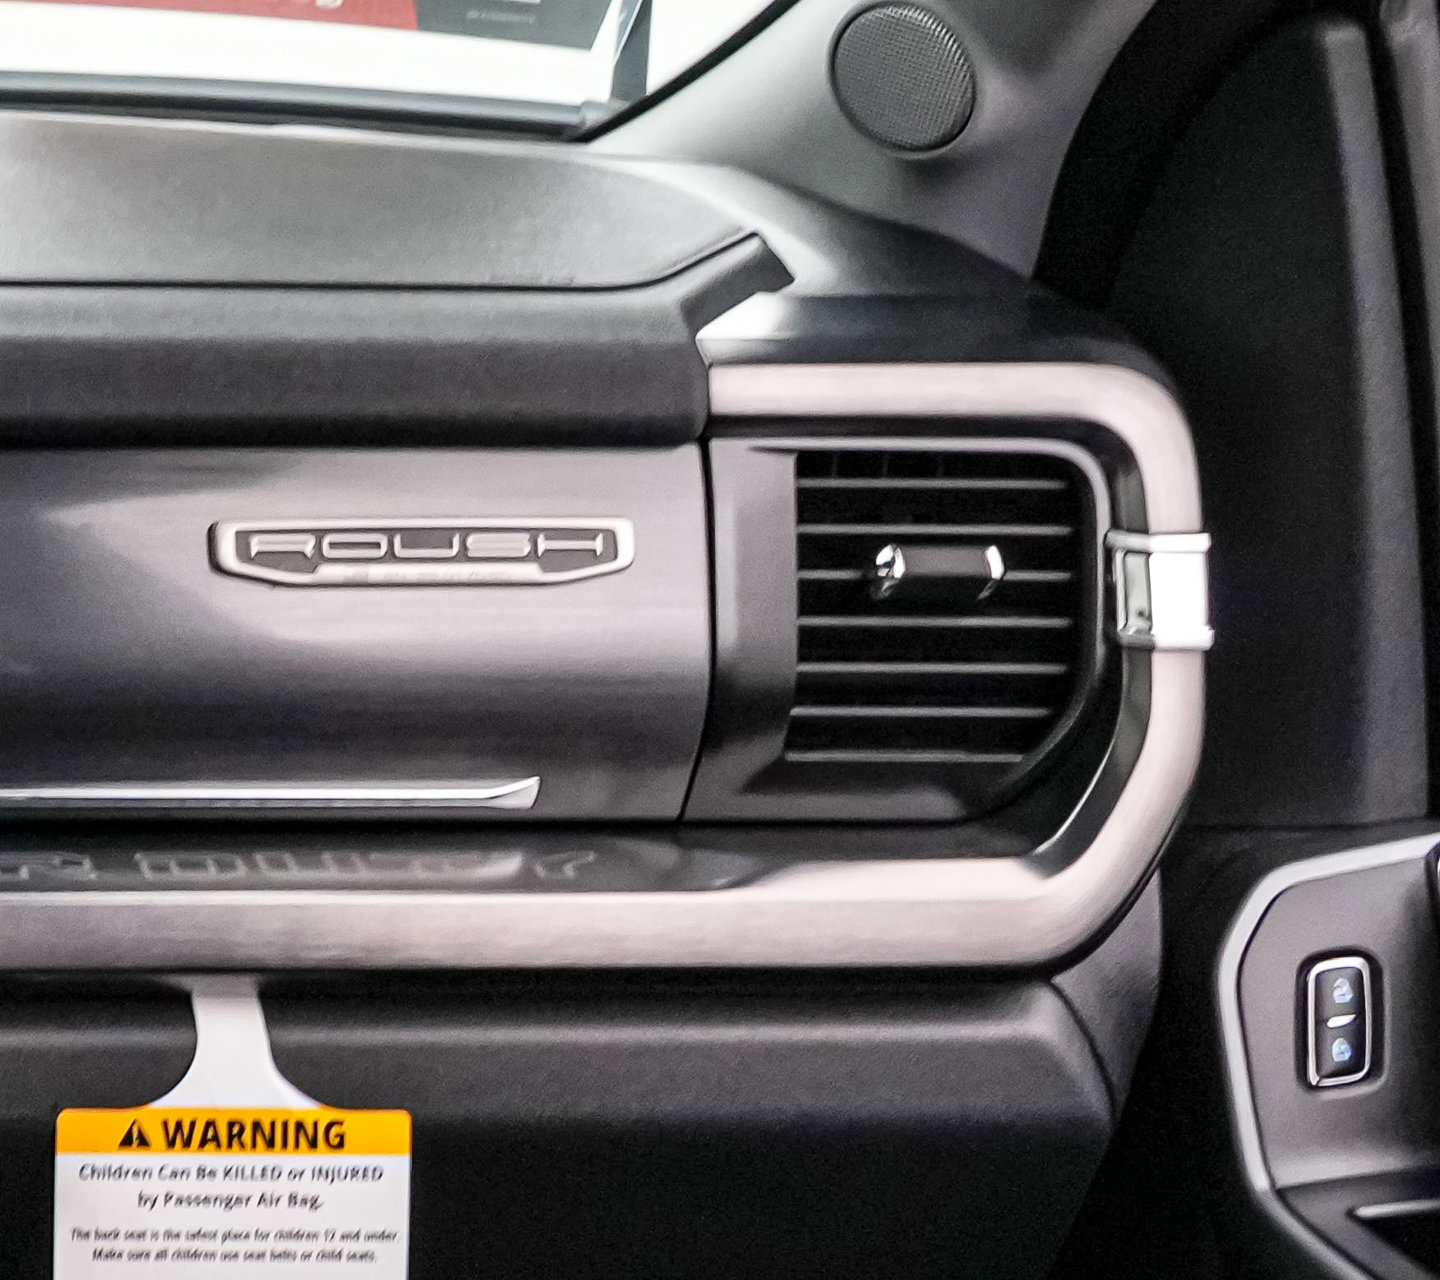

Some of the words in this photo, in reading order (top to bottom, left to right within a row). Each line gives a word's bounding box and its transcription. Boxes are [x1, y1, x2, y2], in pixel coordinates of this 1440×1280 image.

[248, 532, 605, 560] ROUSH
[162, 1119, 346, 1150] WARNING
[79, 1163, 153, 1182] Children
[158, 1164, 191, 1182] Can
[196, 1164, 217, 1182] Be
[223, 1164, 282, 1182] KILLED
[287, 1168, 305, 1182] or
[311, 1163, 385, 1185] INJURED
[137, 1191, 159, 1212] by
[163, 1191, 251, 1212] Passenger
[257, 1191, 282, 1208] Air
